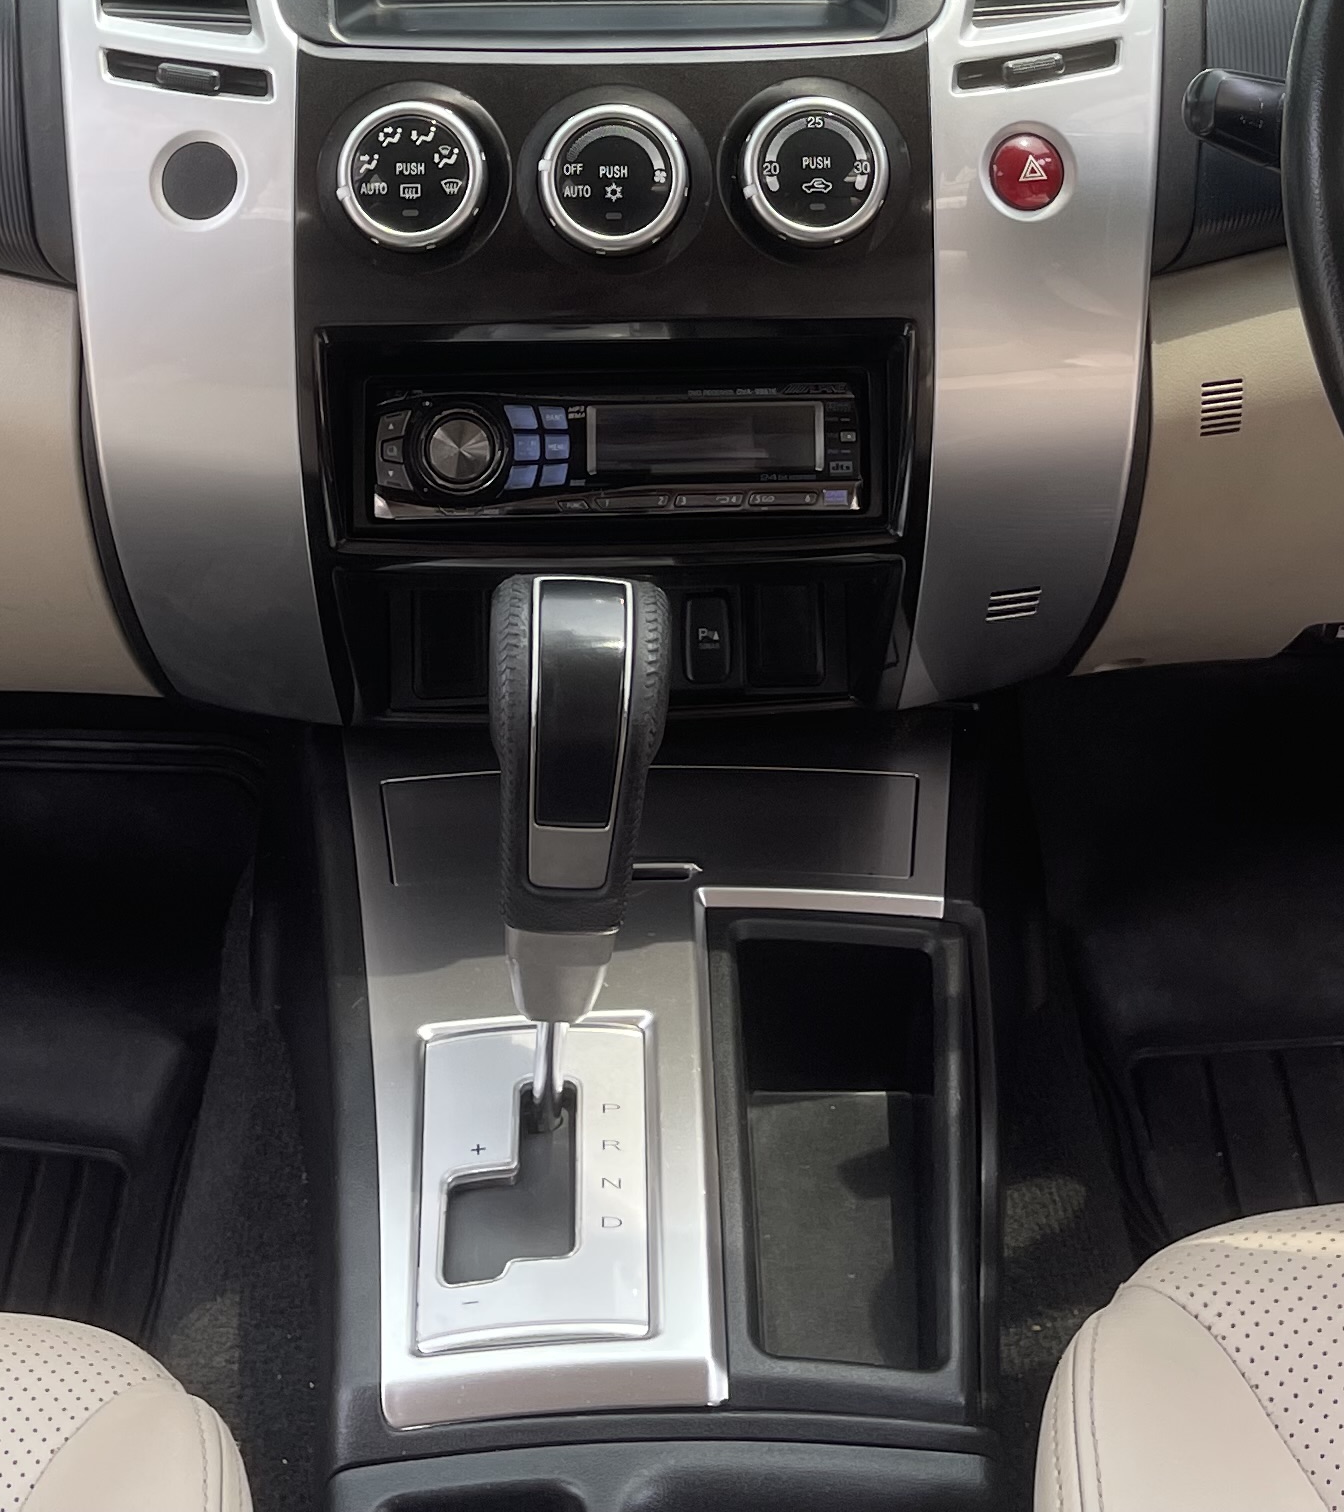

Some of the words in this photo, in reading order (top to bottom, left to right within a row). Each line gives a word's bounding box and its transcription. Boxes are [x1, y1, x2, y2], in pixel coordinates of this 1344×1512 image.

[807, 116, 824, 128] 25
[763, 163, 780, 175] 20
[802, 157, 831, 169] PUSH
[854, 161, 870, 174] 30
[395, 163, 425, 176] PUSH
[563, 164, 583, 175] OFF
[599, 166, 628, 178] PUSH
[360, 183, 388, 195] AUTO
[563, 185, 592, 198] AUTO
[602, 1103, 621, 1114] P
[602, 1140, 621, 1150] R
[602, 1177, 622, 1189] N
[602, 1216, 623, 1228] D
